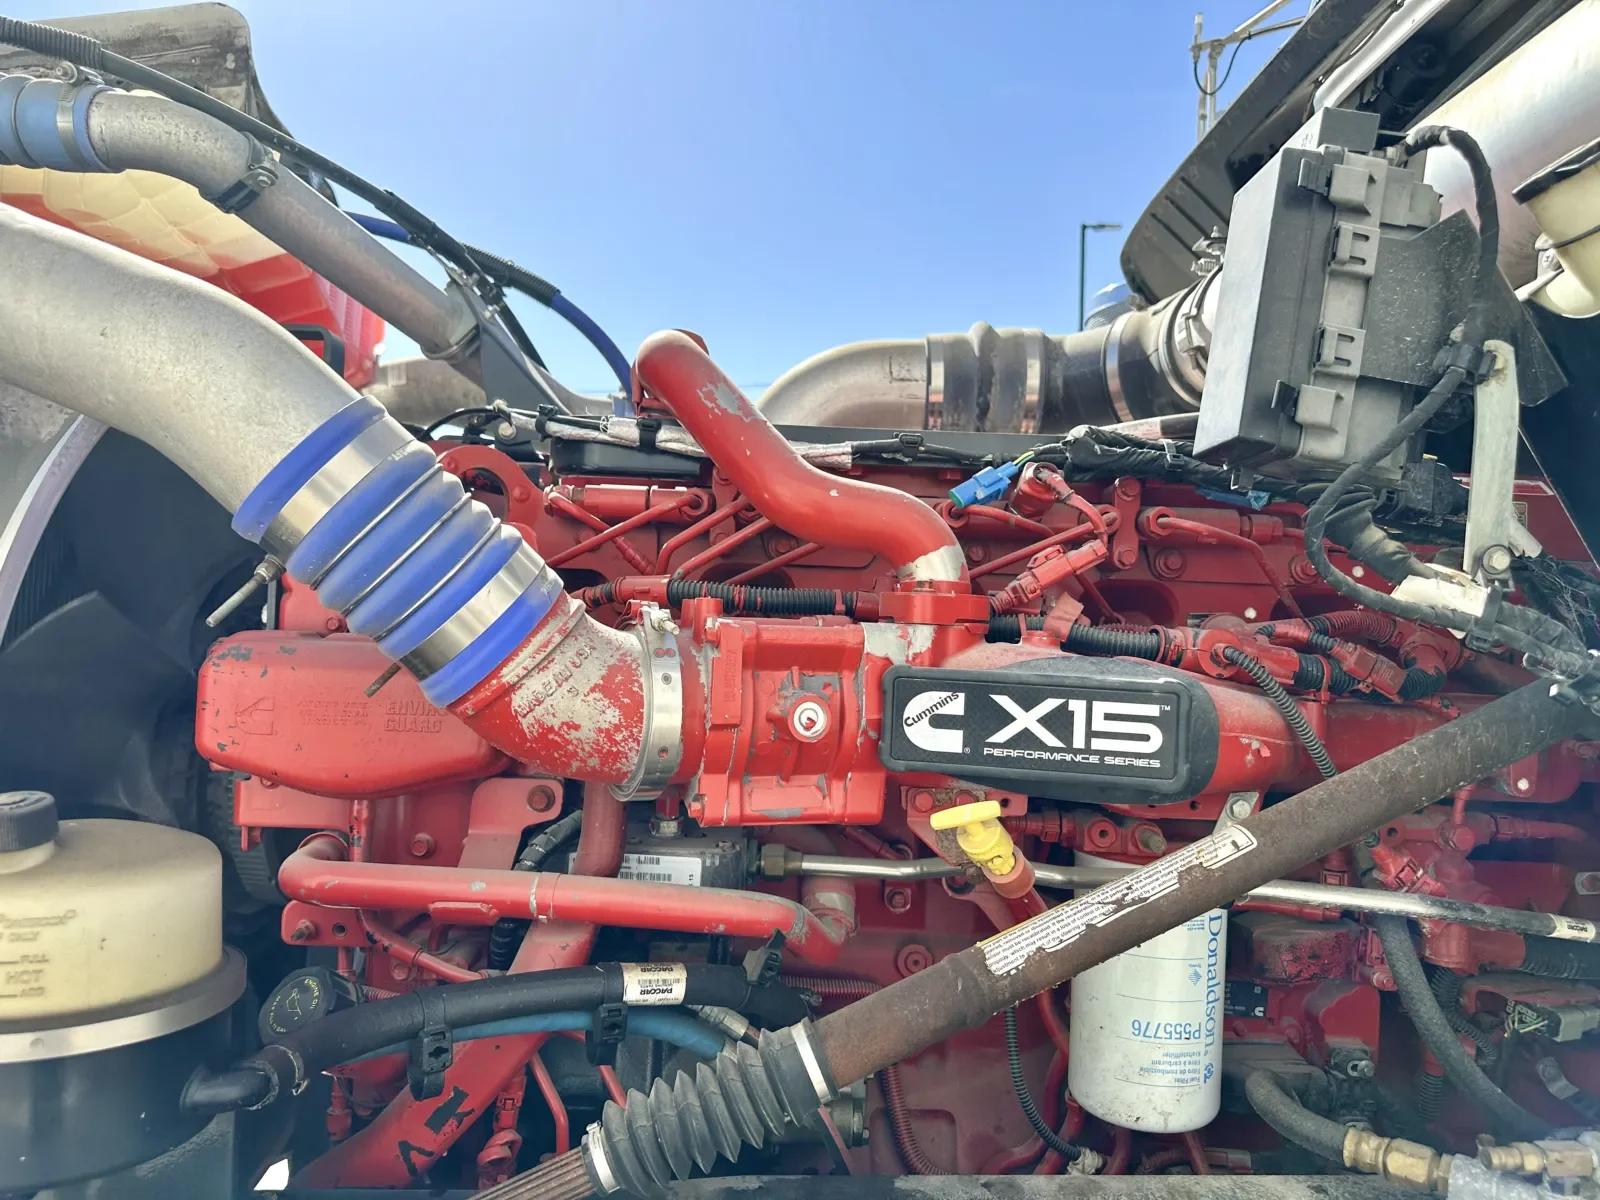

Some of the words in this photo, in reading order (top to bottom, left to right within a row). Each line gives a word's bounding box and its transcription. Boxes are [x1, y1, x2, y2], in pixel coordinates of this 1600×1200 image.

[904, 691, 959, 728] Cummins
[384, 715, 443, 732] GUARD
[984, 694, 1163, 753] X15
[983, 747, 1100, 764] PERFORMANCE
[1103, 755, 1161, 769] SERIES
[6, 969, 44, 985] HOT
[304, 978, 320, 997] ENGINE
[1204, 914, 1223, 1048] Donaldson
[1131, 1019, 1202, 1041] P555776
[1151, 1058, 1181, 1068] carburant
